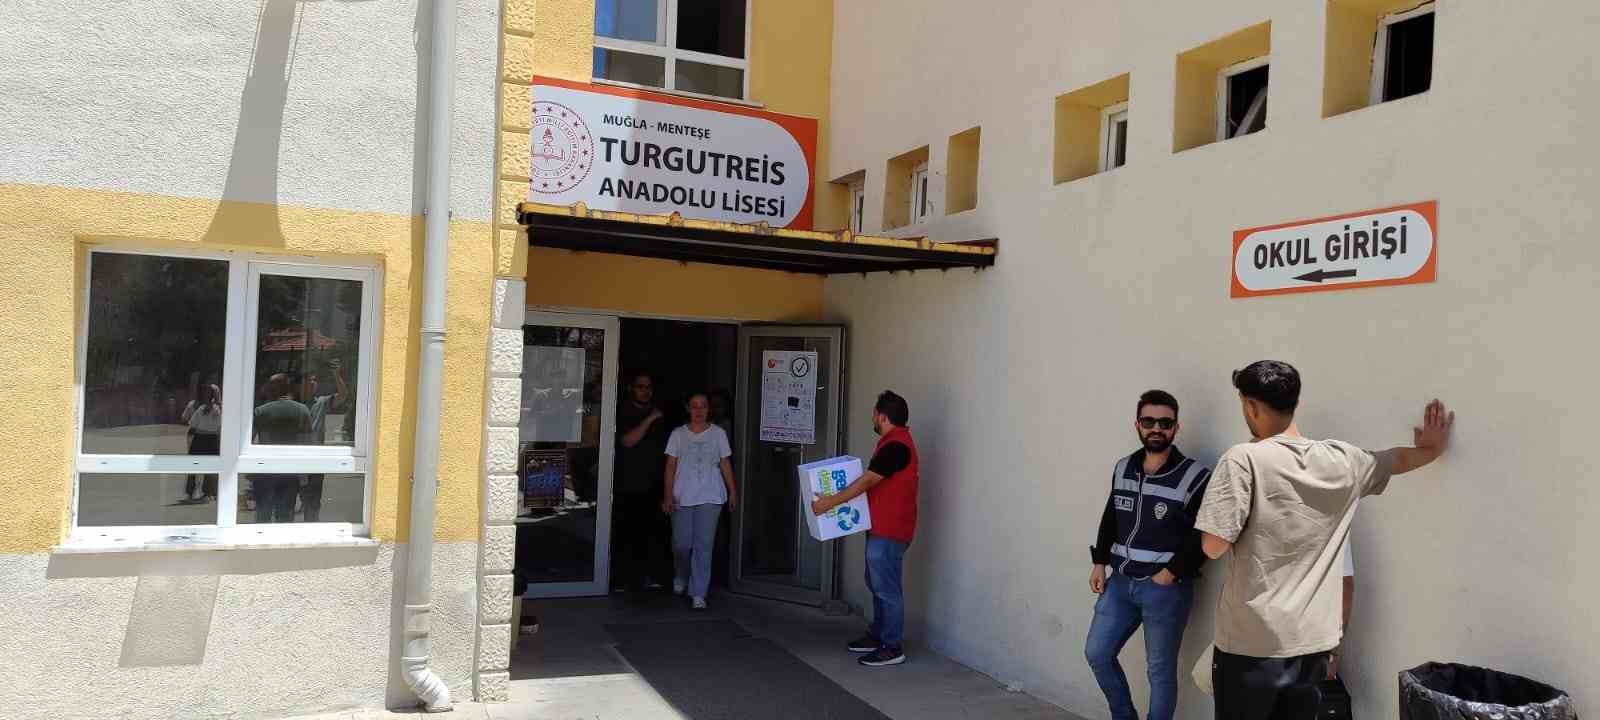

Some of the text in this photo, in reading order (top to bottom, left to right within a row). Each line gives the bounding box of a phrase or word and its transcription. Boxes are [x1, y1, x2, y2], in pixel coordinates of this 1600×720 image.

[603, 114, 647, 130] MUĞLA
[657, 122, 711, 139] MENTEŞE
[600, 137, 785, 186] TURGUTREİS
[599, 177, 785, 218] ANADOLU LİSESİ
[1254, 216, 1407, 270] OKUL GİRİŞİ
